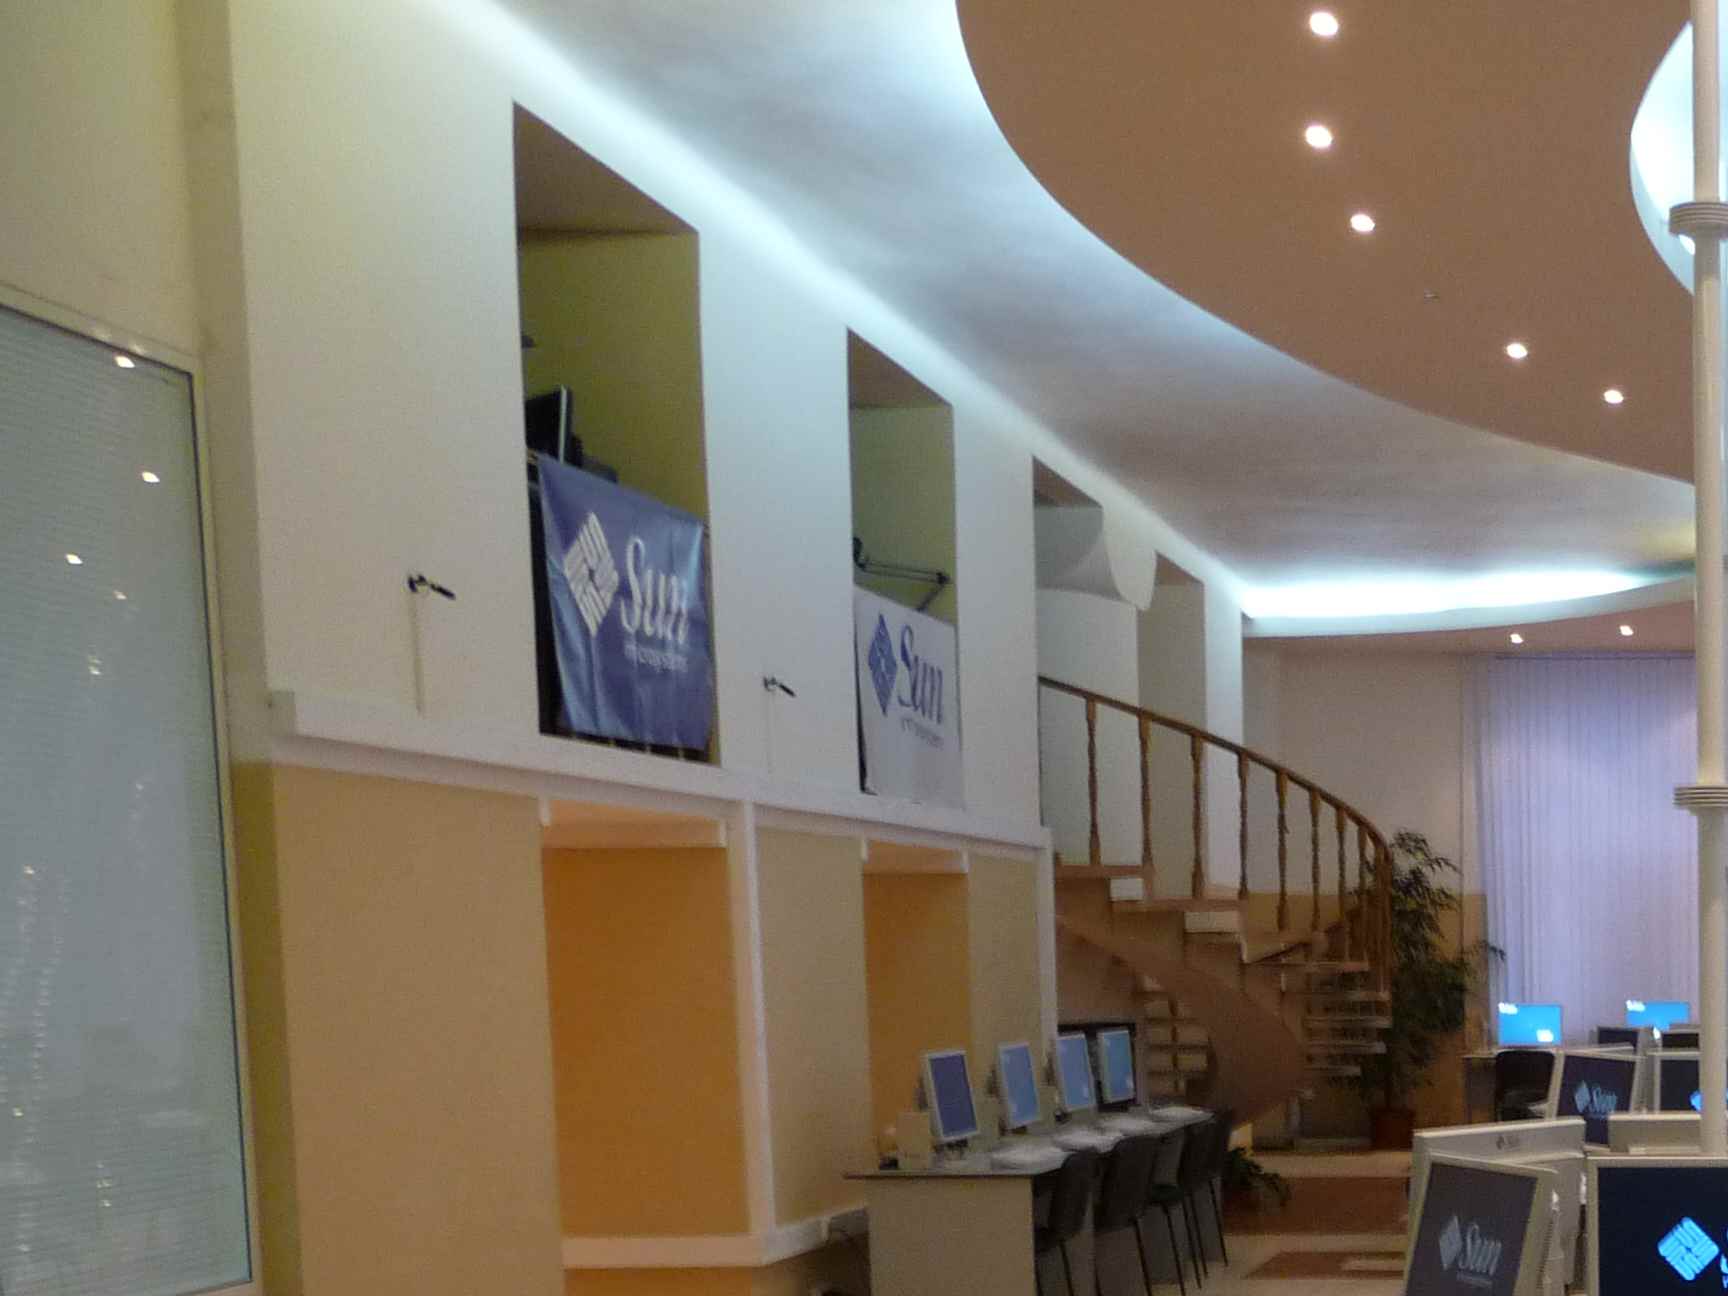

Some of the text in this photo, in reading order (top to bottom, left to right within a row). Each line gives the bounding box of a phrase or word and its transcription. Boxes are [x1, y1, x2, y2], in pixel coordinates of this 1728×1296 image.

[620, 536, 688, 645] Sun
[897, 624, 943, 725] Sun
[1458, 1223, 1502, 1276] Sun
